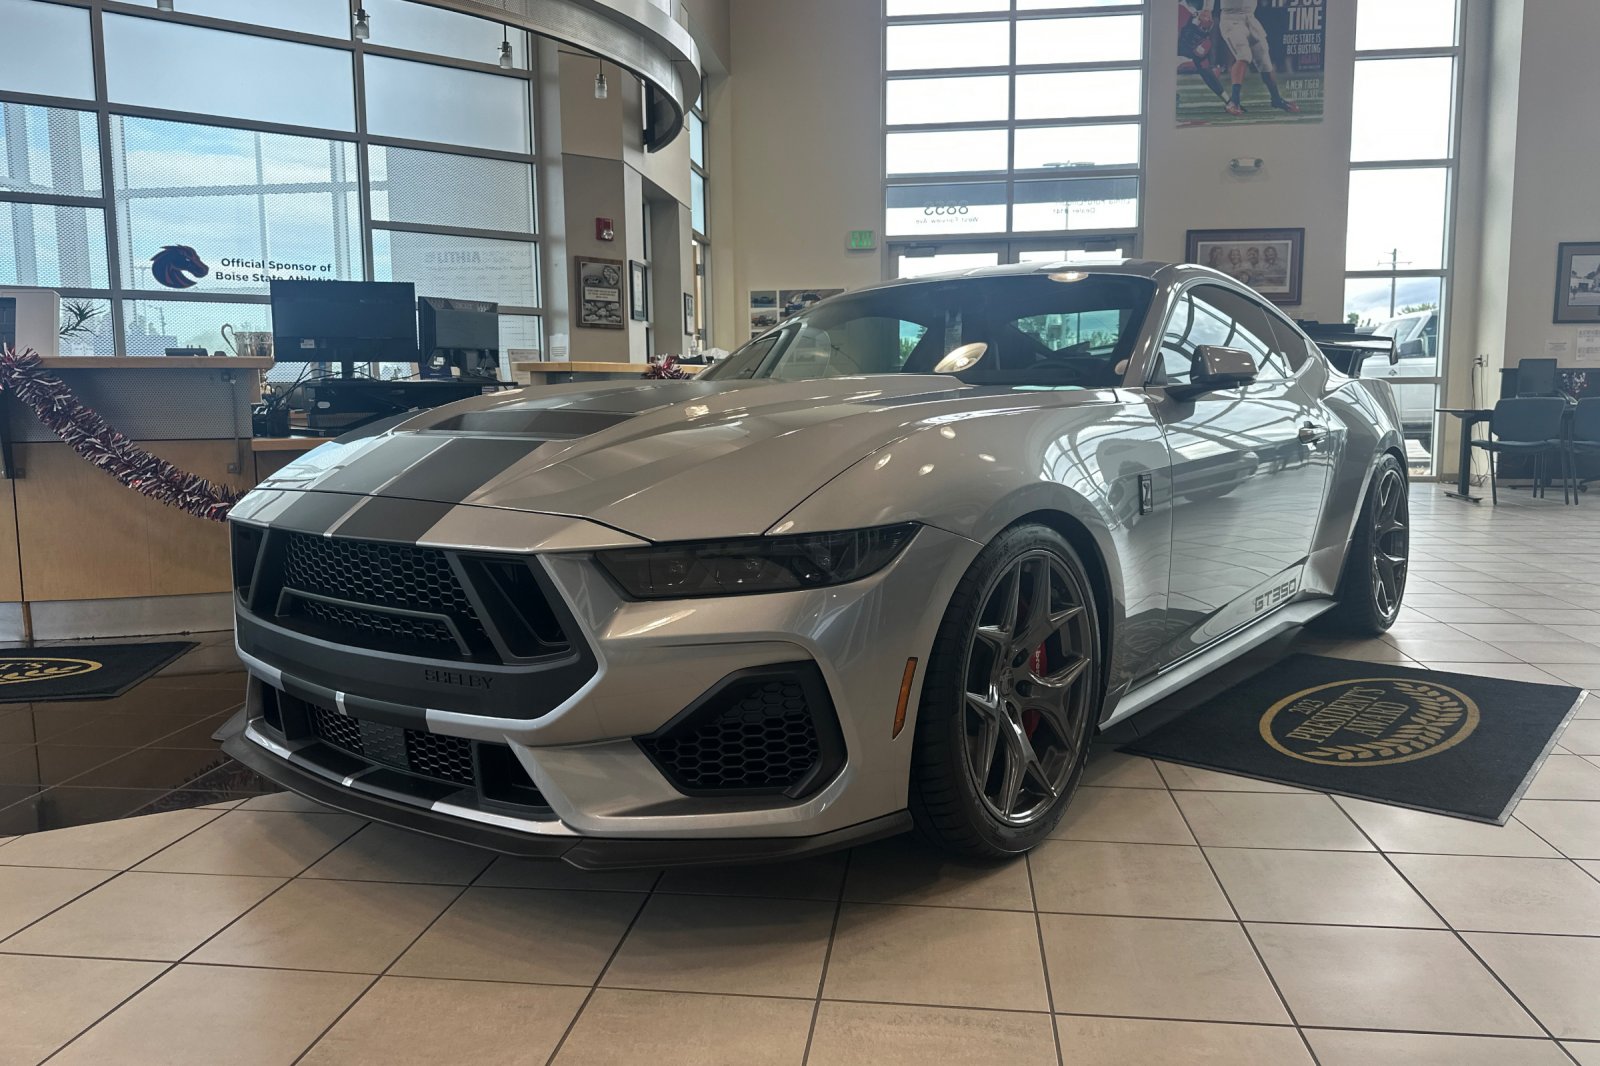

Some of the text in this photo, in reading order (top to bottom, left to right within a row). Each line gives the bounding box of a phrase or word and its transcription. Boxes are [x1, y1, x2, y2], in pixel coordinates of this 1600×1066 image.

[1287, 7, 1322, 31] TIME
[1282, 33, 1321, 45] BOISE STATE IS
[1297, 44, 1321, 54] BUSTING
[1290, 79, 1303, 90] NEW
[221, 258, 332, 273] Official Sponsor of
[215, 272, 249, 282] Boise
[252, 273, 284, 282] State
[1255, 578, 1297, 612] GT350
[425, 669, 493, 689] SHELBY
[1285, 686, 1386, 744] PRESIDENT'S
[1343, 701, 1410, 738] AWARD
